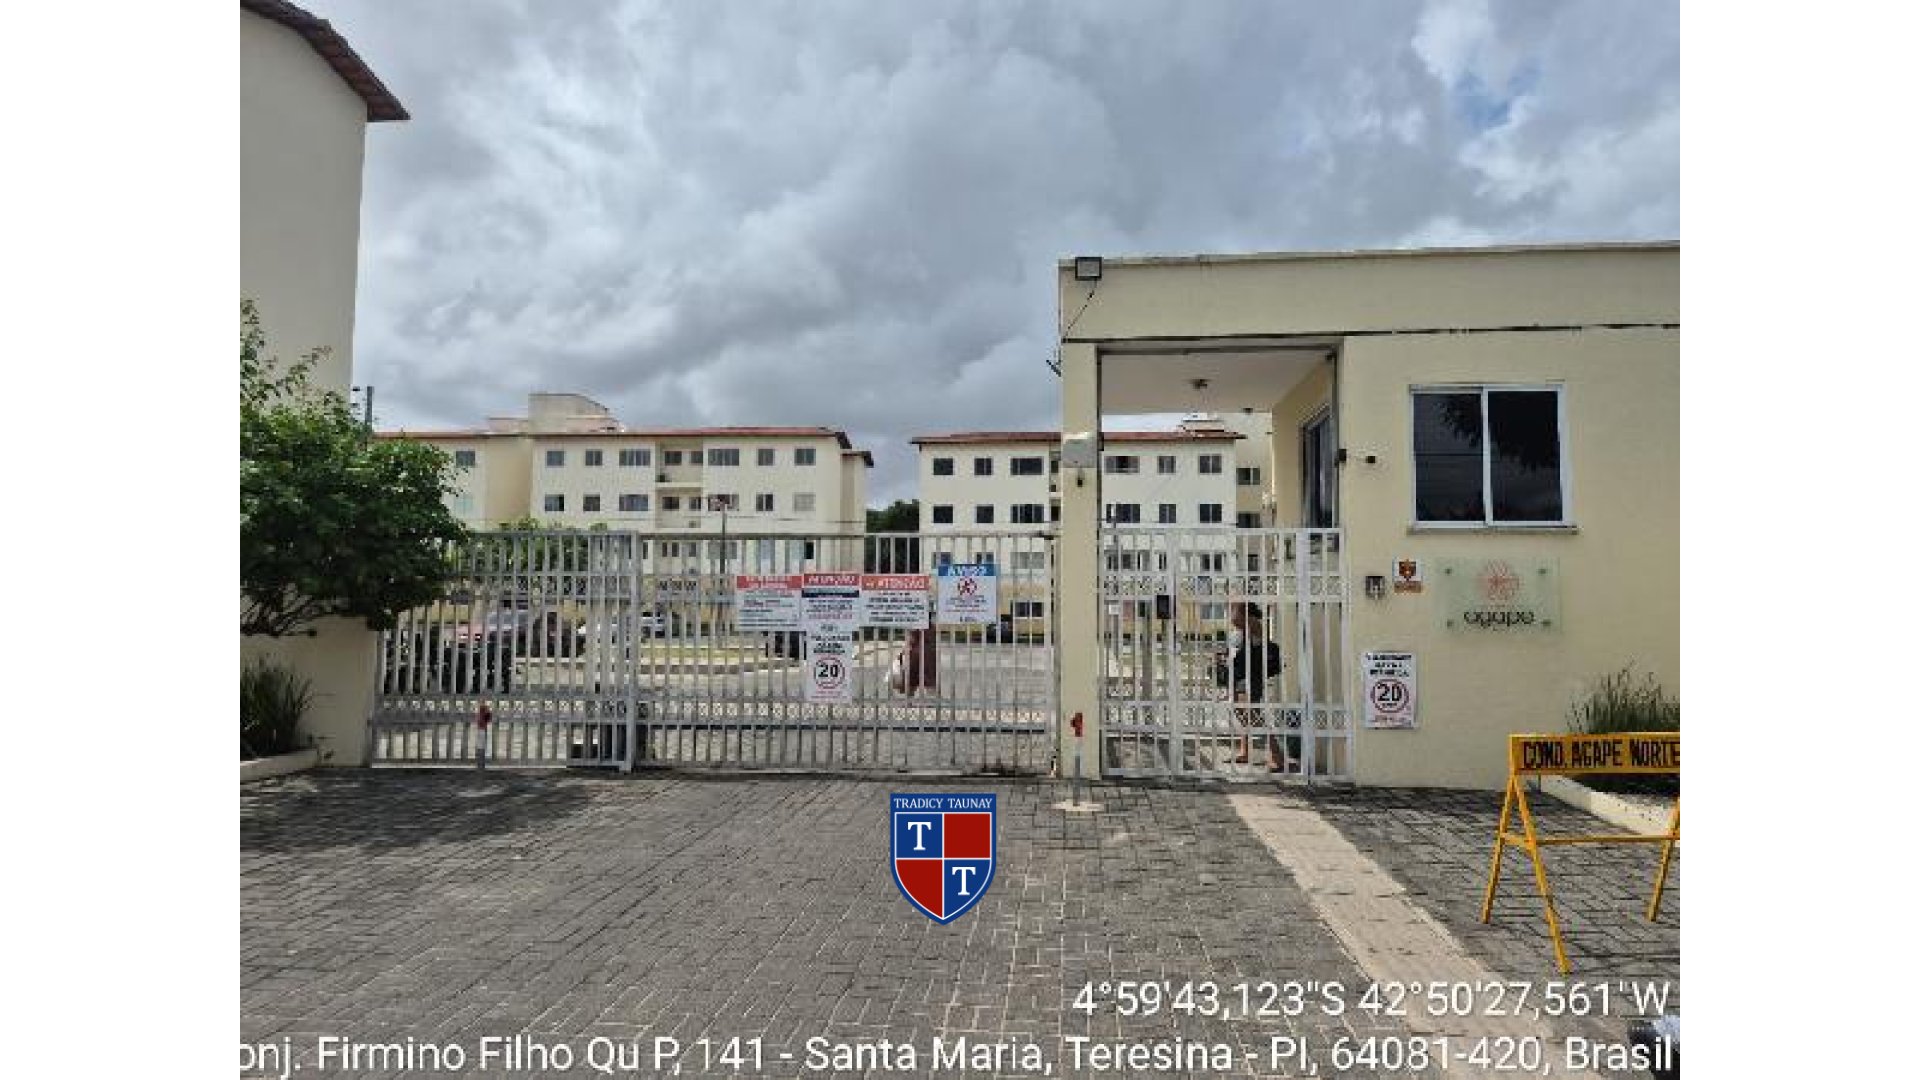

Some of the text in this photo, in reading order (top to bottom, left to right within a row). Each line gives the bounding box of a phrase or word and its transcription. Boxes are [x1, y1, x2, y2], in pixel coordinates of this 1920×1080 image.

[818, 664, 839, 678] 20
[1377, 683, 1402, 702] 20
[1571, 740, 1624, 768] AGAPE
[1629, 738, 1680, 767] NORTE
